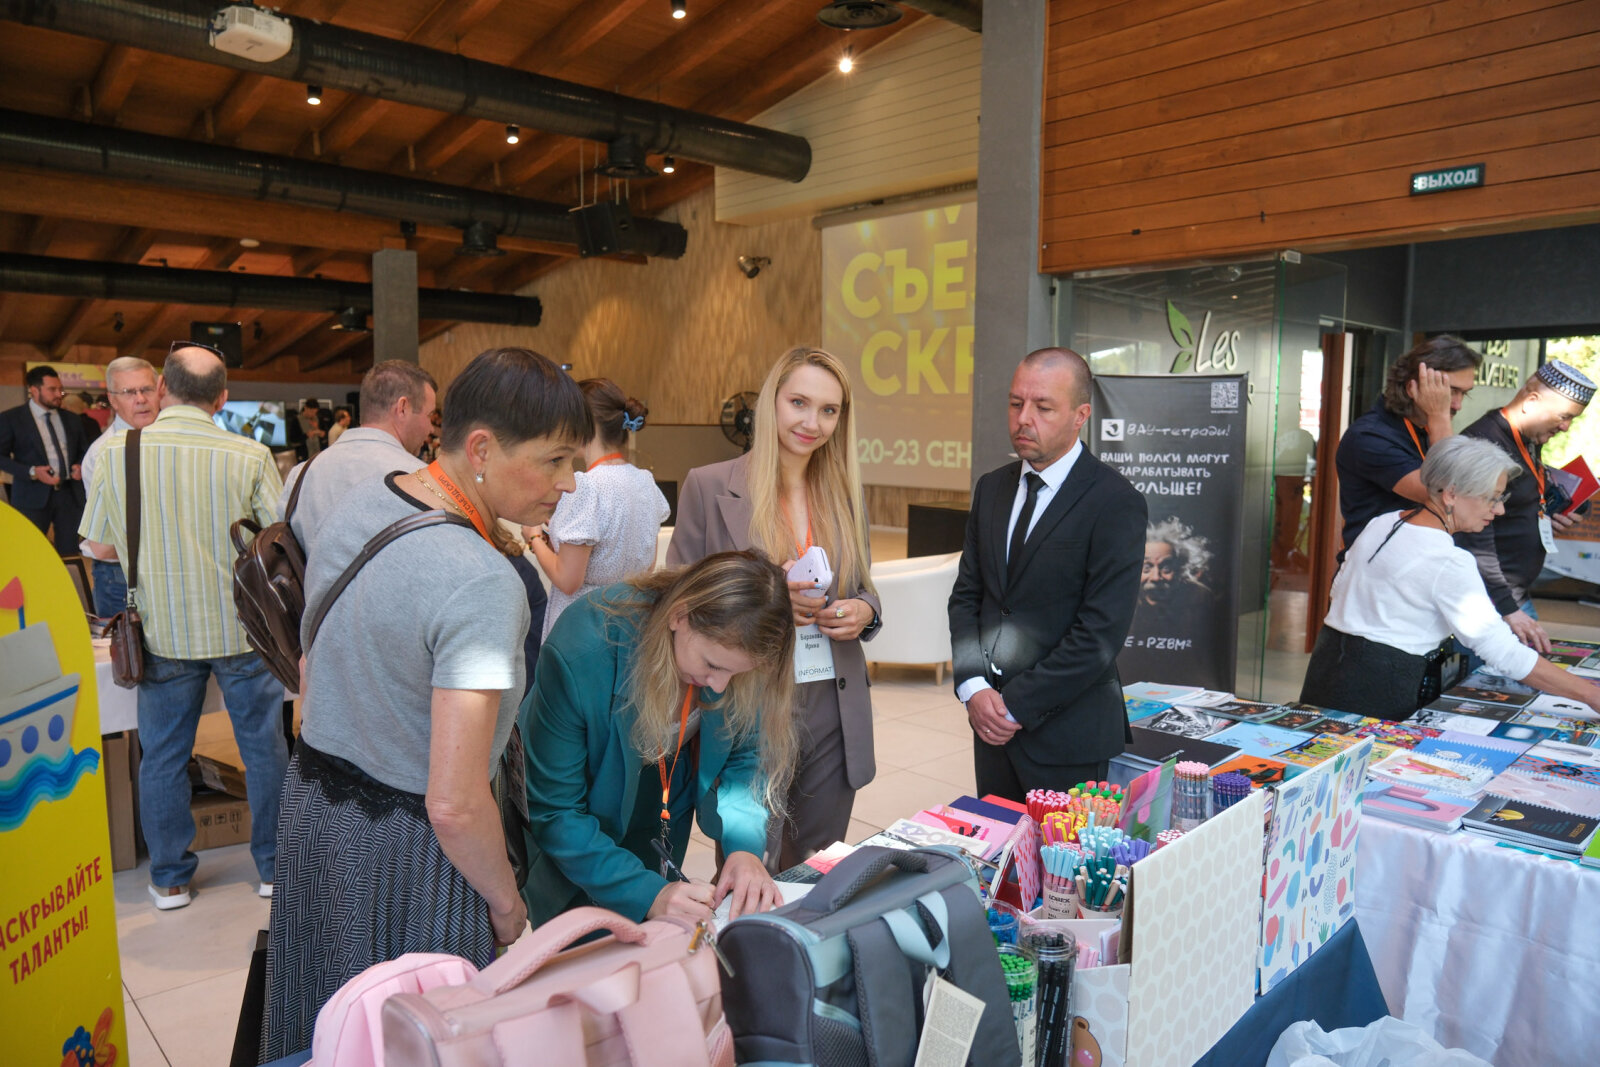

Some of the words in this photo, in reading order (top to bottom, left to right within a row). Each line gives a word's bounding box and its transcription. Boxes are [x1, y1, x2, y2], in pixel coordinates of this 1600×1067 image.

[1417, 168, 1478, 190] ВЫХОД
[841, 240, 977, 318] СЪЕ
[1195, 310, 1240, 373] Les
[1100, 452, 1133, 463] ВАШИ
[1139, 452, 1181, 463] ПОЛКИ
[1186, 453, 1230, 464] МОГУТ
[1117, 466, 1212, 478] ЗАРАБАТЫВАТЬ
[1131, 481, 1202, 496] ОЛЬШЕ!
[1124, 636, 1135, 648] E
[9, 906, 89, 985] ТАЛАНТЫ!
